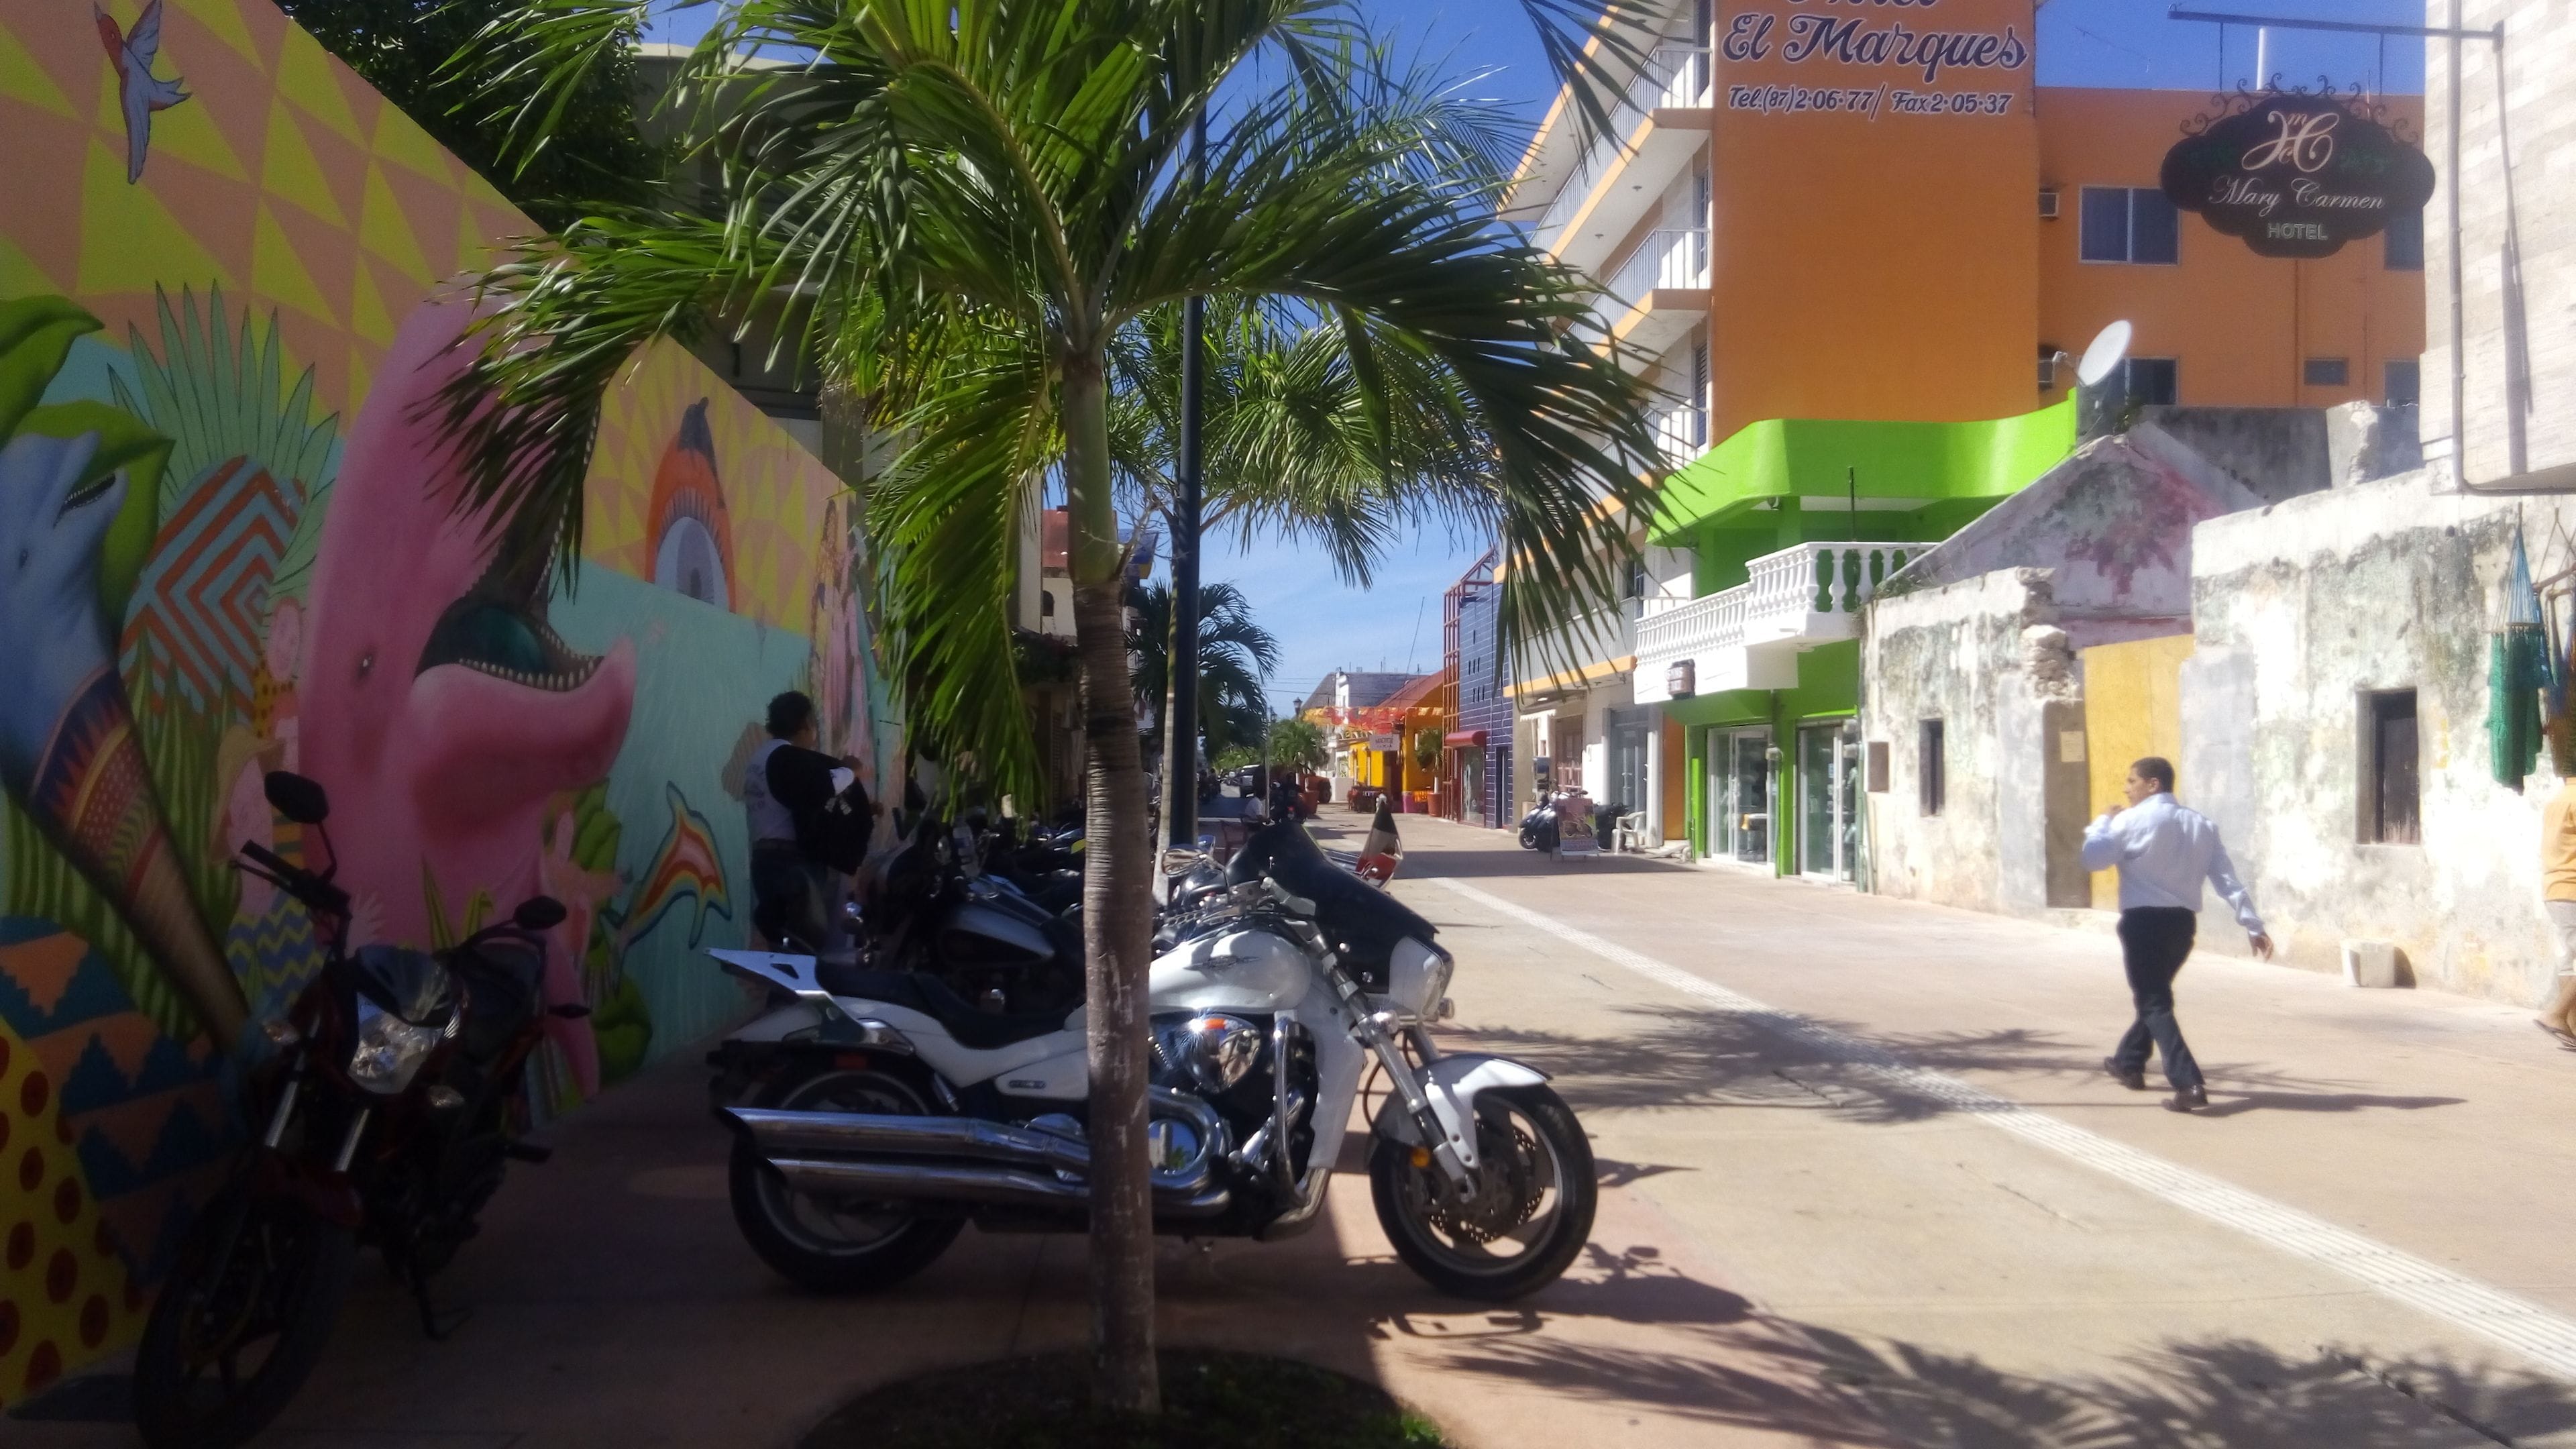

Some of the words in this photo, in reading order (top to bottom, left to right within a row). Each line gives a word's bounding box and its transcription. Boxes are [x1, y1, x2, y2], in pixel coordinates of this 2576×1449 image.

[1722, 13, 1774, 62] El
[1782, 13, 2028, 84] Marques
[2208, 175, 2279, 217] Mary
[2291, 177, 2384, 209] Carmen
[2267, 222, 2328, 241] HOTEL
